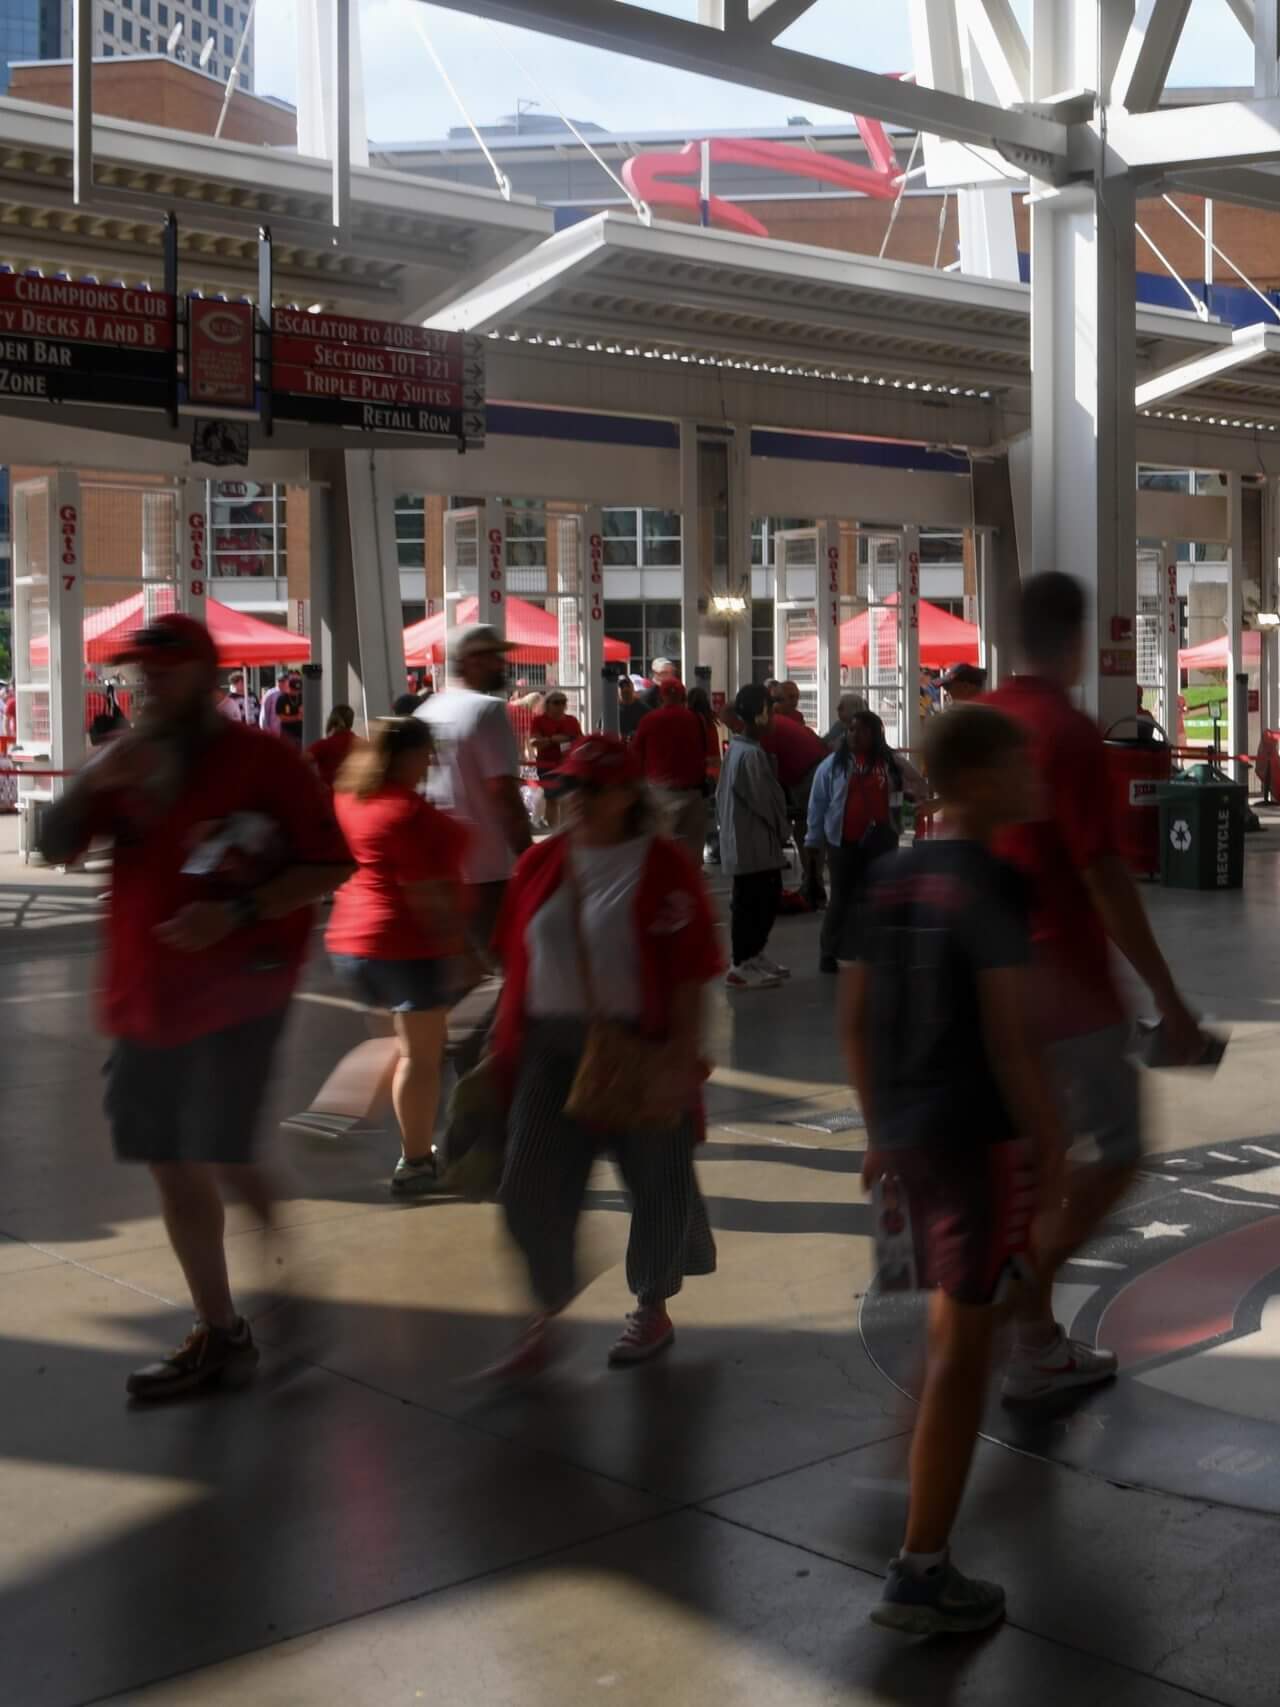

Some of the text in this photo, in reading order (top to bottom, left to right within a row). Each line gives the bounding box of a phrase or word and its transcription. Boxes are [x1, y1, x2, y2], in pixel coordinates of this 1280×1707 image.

[15, 276, 168, 317] CHAMPIONS CLUB
[21, 308, 80, 337] DECKS
[84, 315, 98, 339] A
[103, 322, 140, 343] AND
[143, 322, 157, 345] B
[274, 309, 358, 342] ESCALATOR
[363, 326, 381, 344] TO
[34, 340, 72, 366] BAR
[313, 343, 449, 379] SECTIONS 101-121
[0, 368, 47, 394] ZONE
[303, 370, 451, 405] TRIPLE PLAY SUITES
[363, 404, 451, 433] RETAIL ROW
[60, 505, 77, 592] Gate 7
[189, 513, 204, 596] Gate 8
[489, 527, 502, 604] Gate 9
[590, 534, 602, 621] Gate 10
[1217, 808, 1229, 887] RECYCLE
